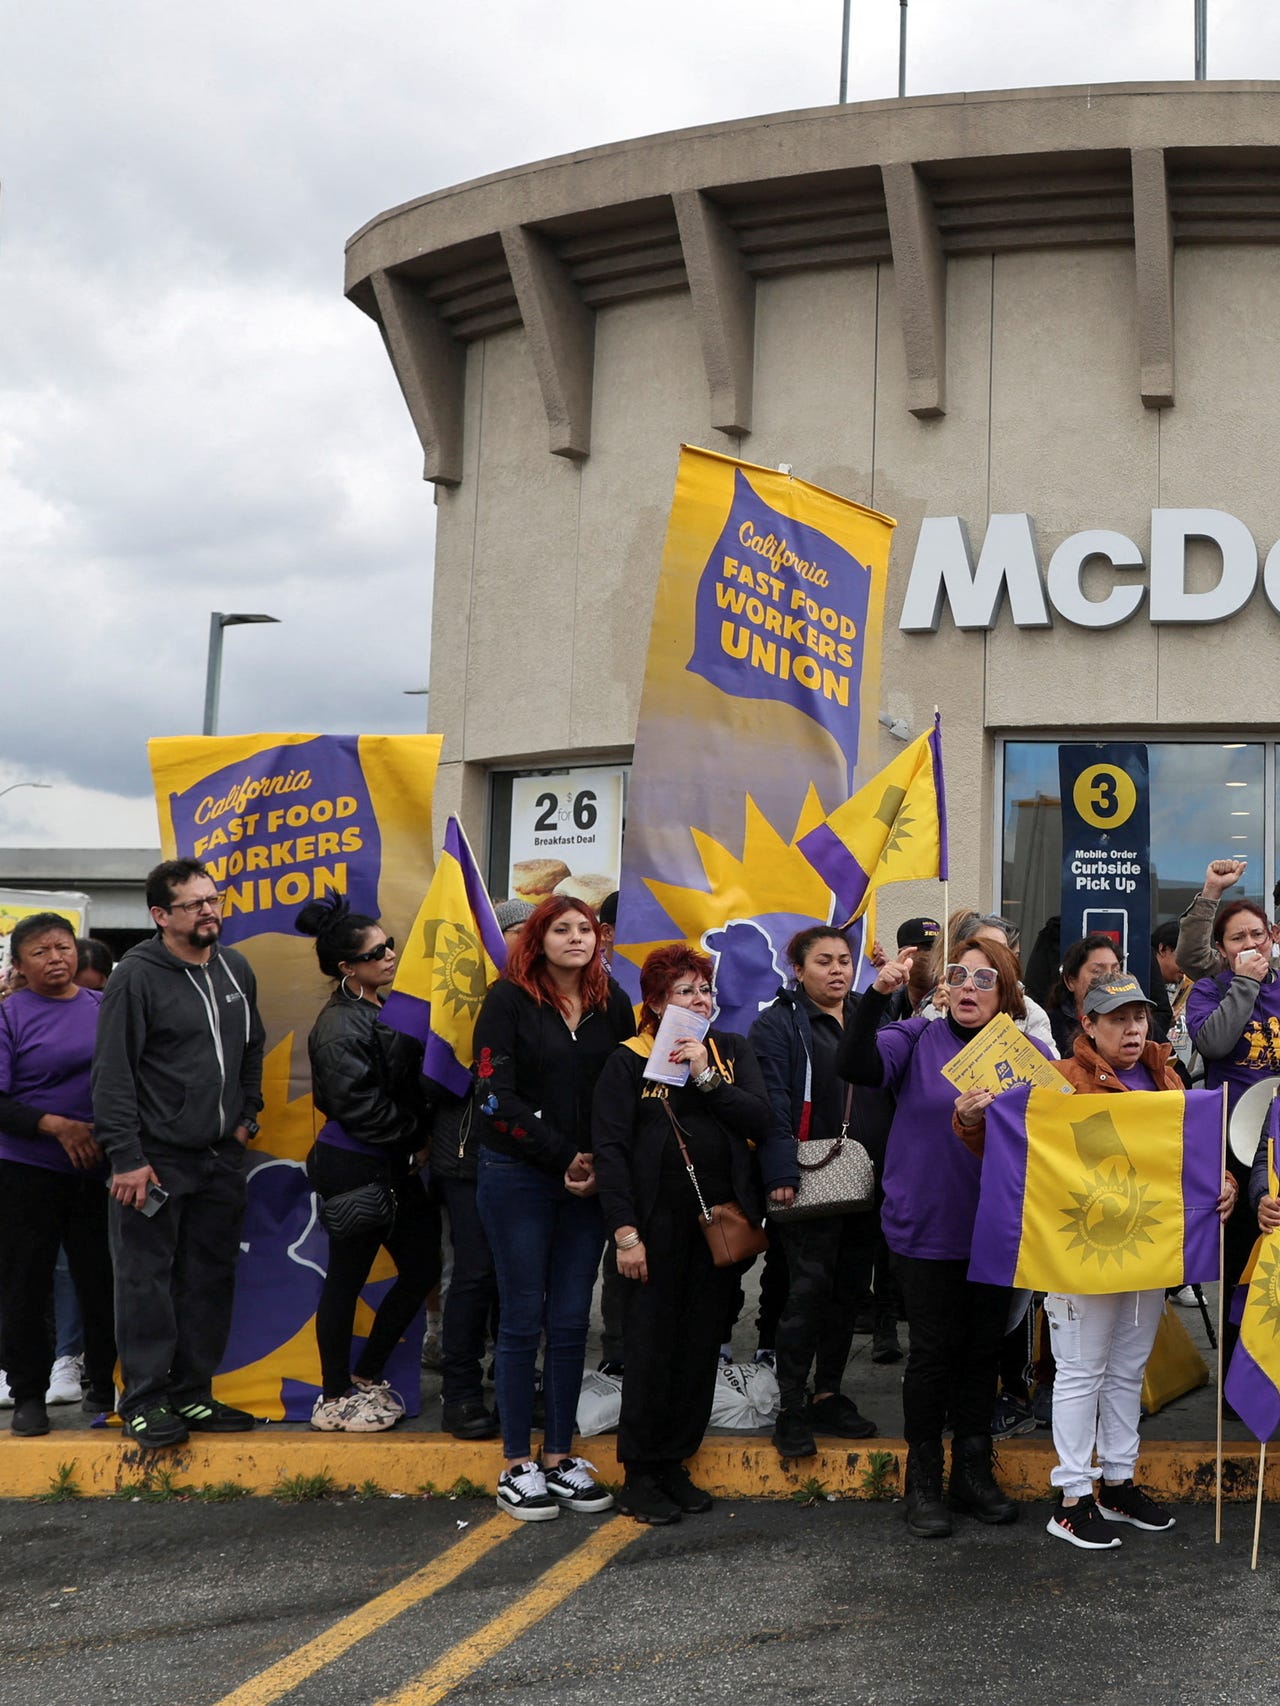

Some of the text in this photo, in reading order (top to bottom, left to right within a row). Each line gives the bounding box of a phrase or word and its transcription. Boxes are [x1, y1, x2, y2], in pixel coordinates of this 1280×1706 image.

[739, 521, 829, 588] California
[715, 582, 853, 668] WORKERS
[723, 556, 857, 640] FAST FOOD
[720, 620, 849, 707] UNION
[194, 770, 312, 824] California
[534, 792, 559, 831] 2
[1090, 772, 1119, 819] 3
[193, 796, 358, 858] FAST FOOD
[534, 834, 596, 846] Breakfast Deal
[1071, 861, 1141, 875] Curbside
[1075, 850, 1137, 859] Mobile Order
[217, 863, 347, 918] NION
[1076, 877, 1137, 893] Pick Up
